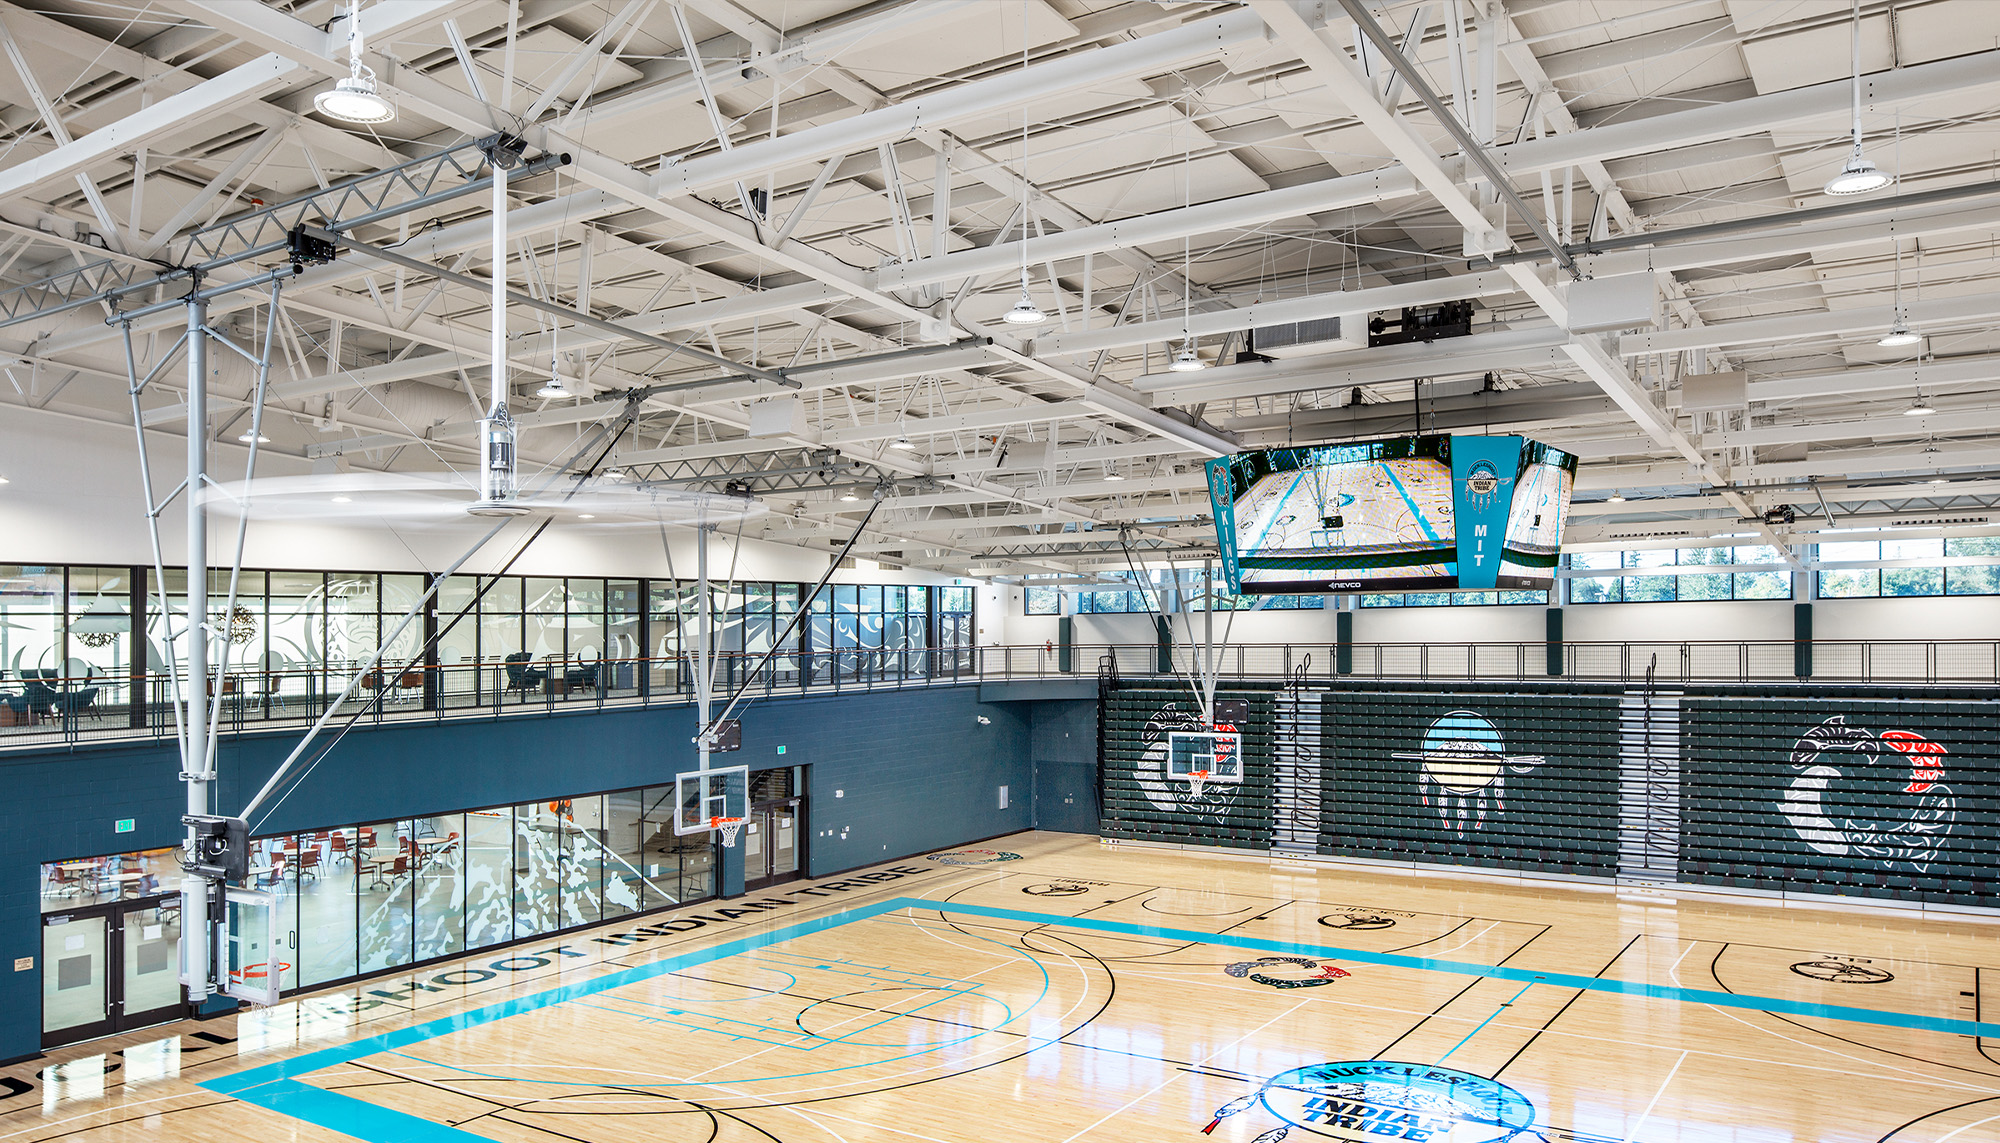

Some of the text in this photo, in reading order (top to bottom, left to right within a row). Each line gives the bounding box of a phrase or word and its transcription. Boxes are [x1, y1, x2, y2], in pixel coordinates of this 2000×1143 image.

[1221, 510, 1237, 590] KINGS
[1474, 524, 1487, 566] MIT
[590, 898, 798, 946] INDIAN
[785, 865, 933, 897] TRIBE
[1822, 955, 1873, 964] ELK
[1302, 1097, 1457, 1133] INDIAN
[1303, 1109, 1434, 1143] TRIBE
